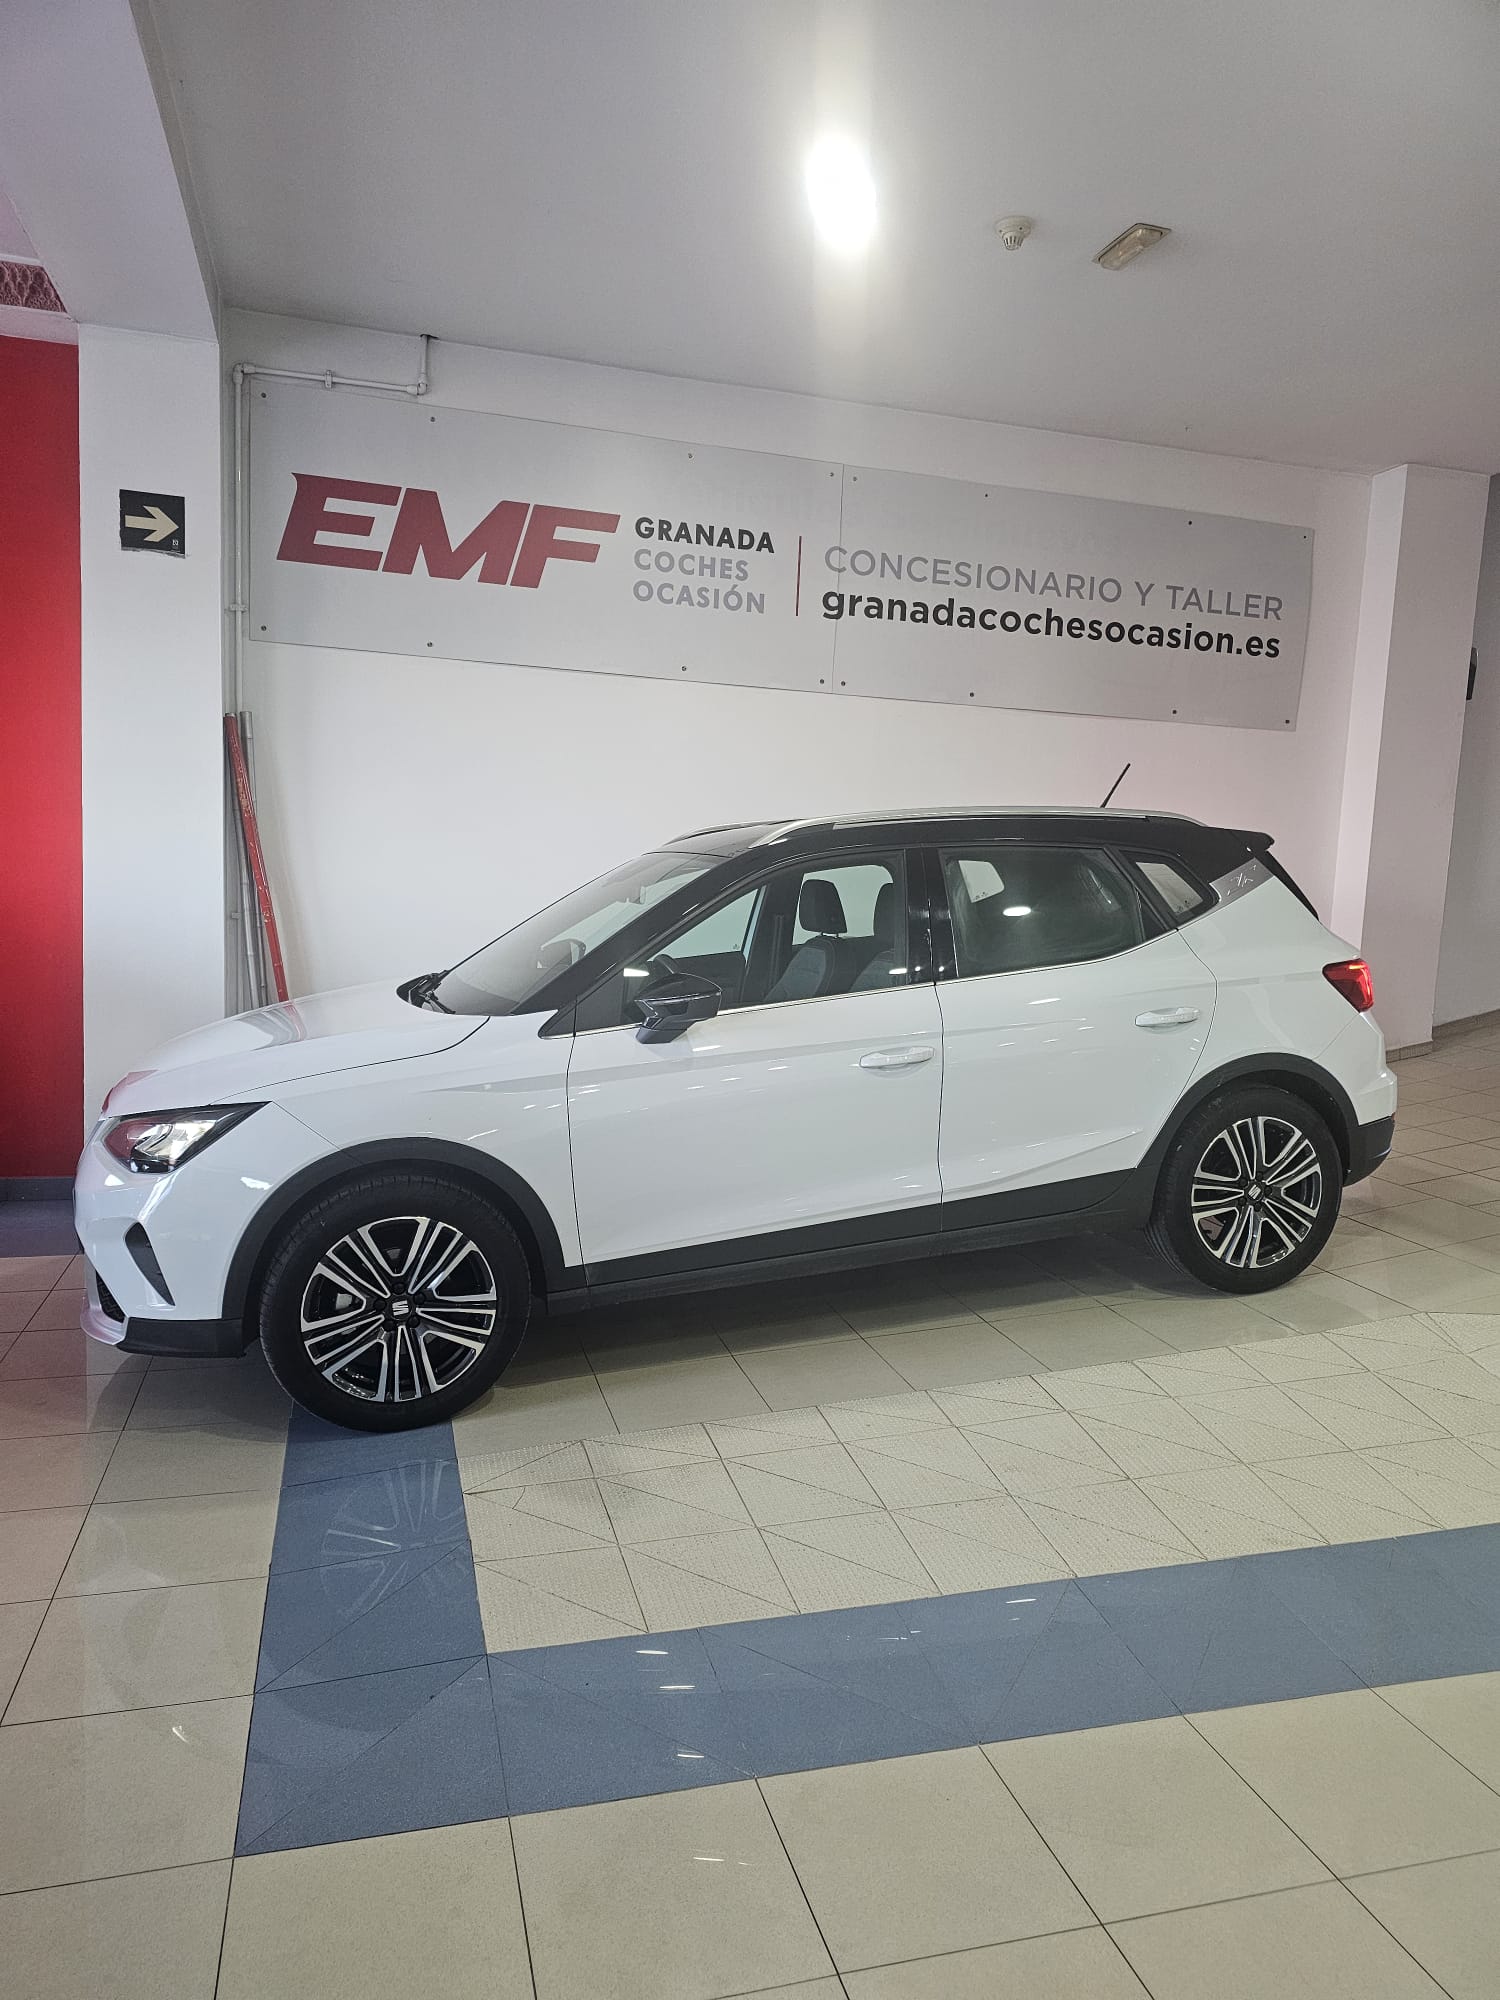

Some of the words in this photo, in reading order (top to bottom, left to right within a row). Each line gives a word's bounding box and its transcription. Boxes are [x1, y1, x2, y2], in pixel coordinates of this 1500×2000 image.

[276, 472, 621, 589] EMF
[635, 517, 775, 553] GRANADA
[633, 549, 749, 581] COCHES
[825, 545, 1122, 604] CONCESIONARIO
[1134, 581, 1155, 606] Y
[1166, 585, 1282, 620] TALLER
[632, 580, 765, 614] OCASIÓN
[822, 590, 1281, 658] granadacochesocasion.es
